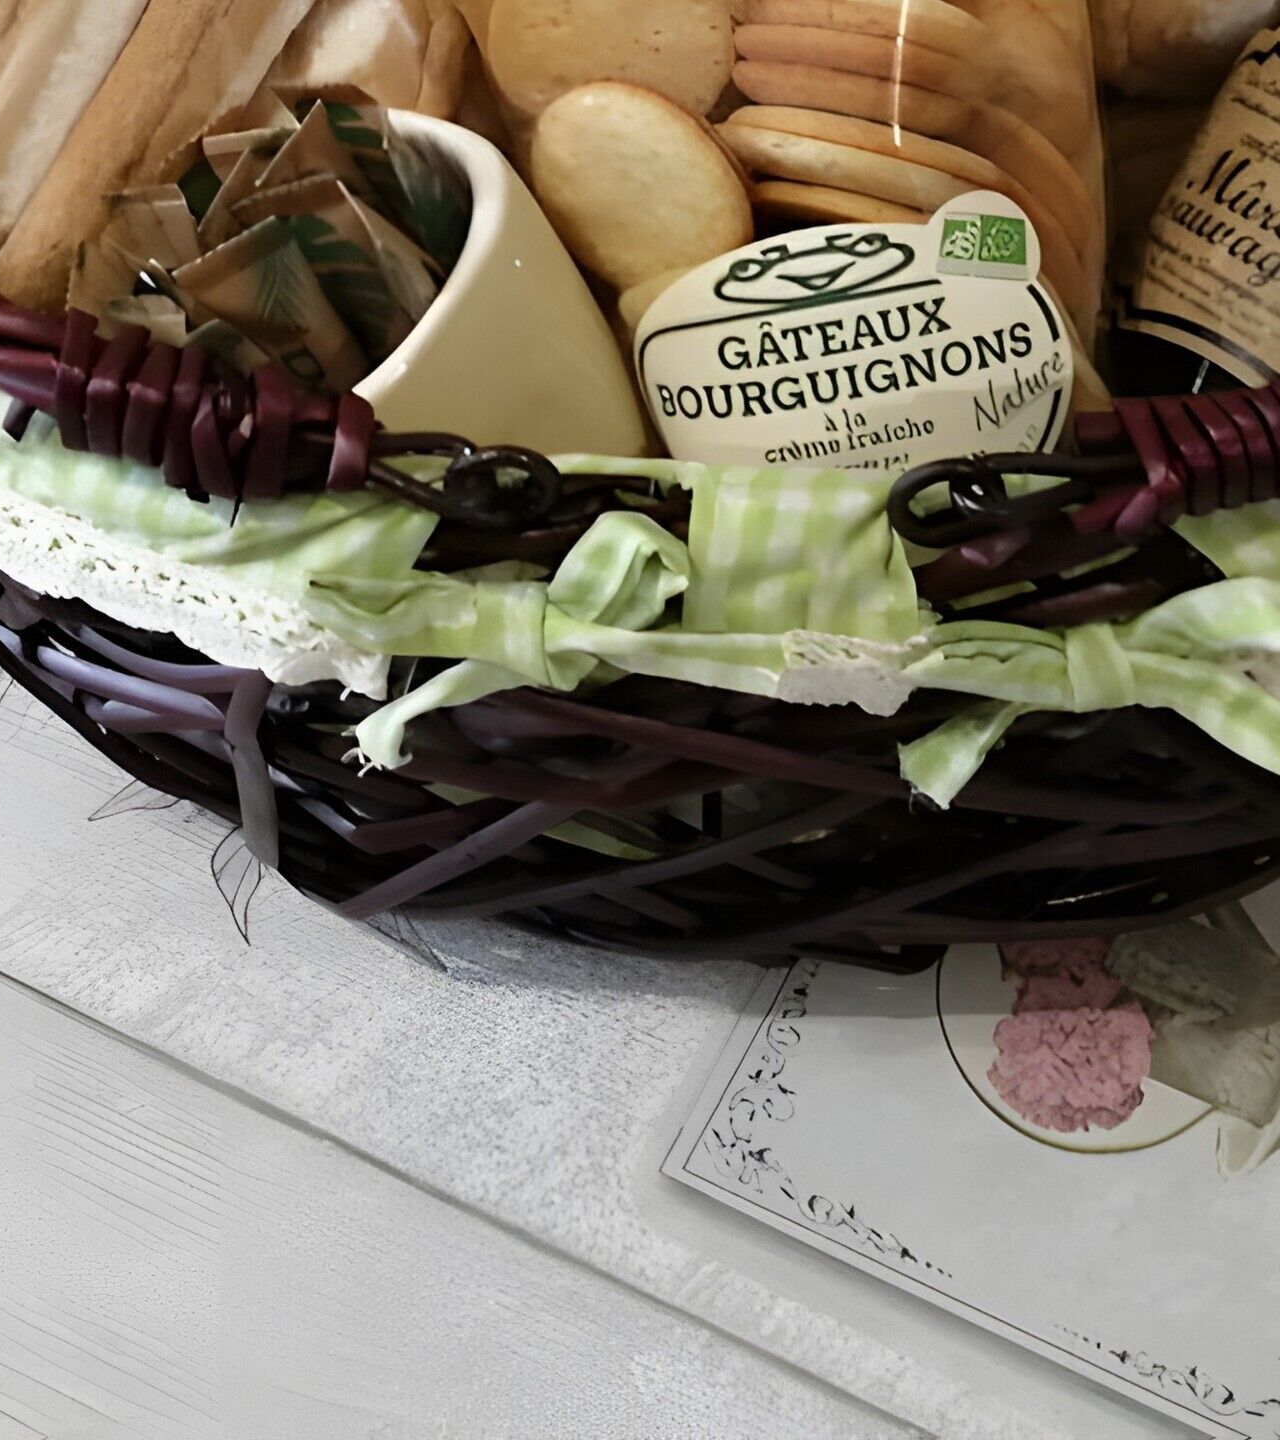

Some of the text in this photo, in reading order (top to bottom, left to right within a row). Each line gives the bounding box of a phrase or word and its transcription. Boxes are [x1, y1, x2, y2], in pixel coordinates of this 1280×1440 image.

[655, 321, 1034, 420] BOURGUIGNONS
[717, 295, 952, 371] GÂTEAUX
[972, 351, 1066, 433] Nature
